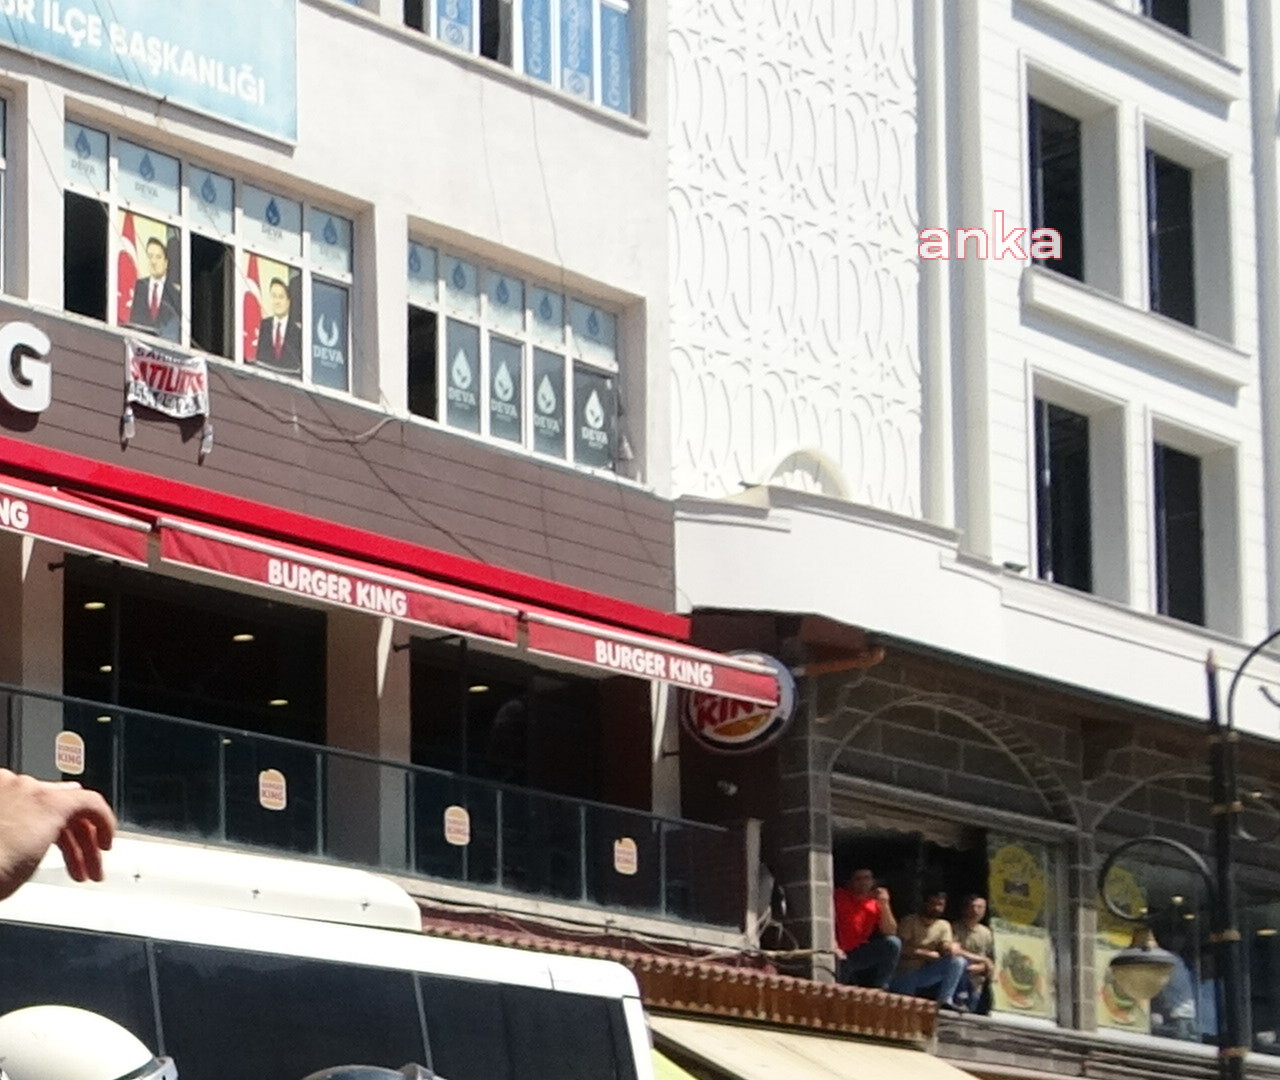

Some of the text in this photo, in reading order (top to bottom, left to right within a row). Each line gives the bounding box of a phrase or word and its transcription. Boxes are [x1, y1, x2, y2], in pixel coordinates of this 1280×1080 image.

[110, 23, 266, 105] BAŞKANLIĞI
[313, 346, 344, 365] DEVA
[448, 386, 476, 406] DEVA
[491, 401, 518, 420] DEVA
[582, 426, 609, 445] DEVA
[268, 558, 407, 616] BURGER KING
[595, 639, 713, 688] BURGER KING
